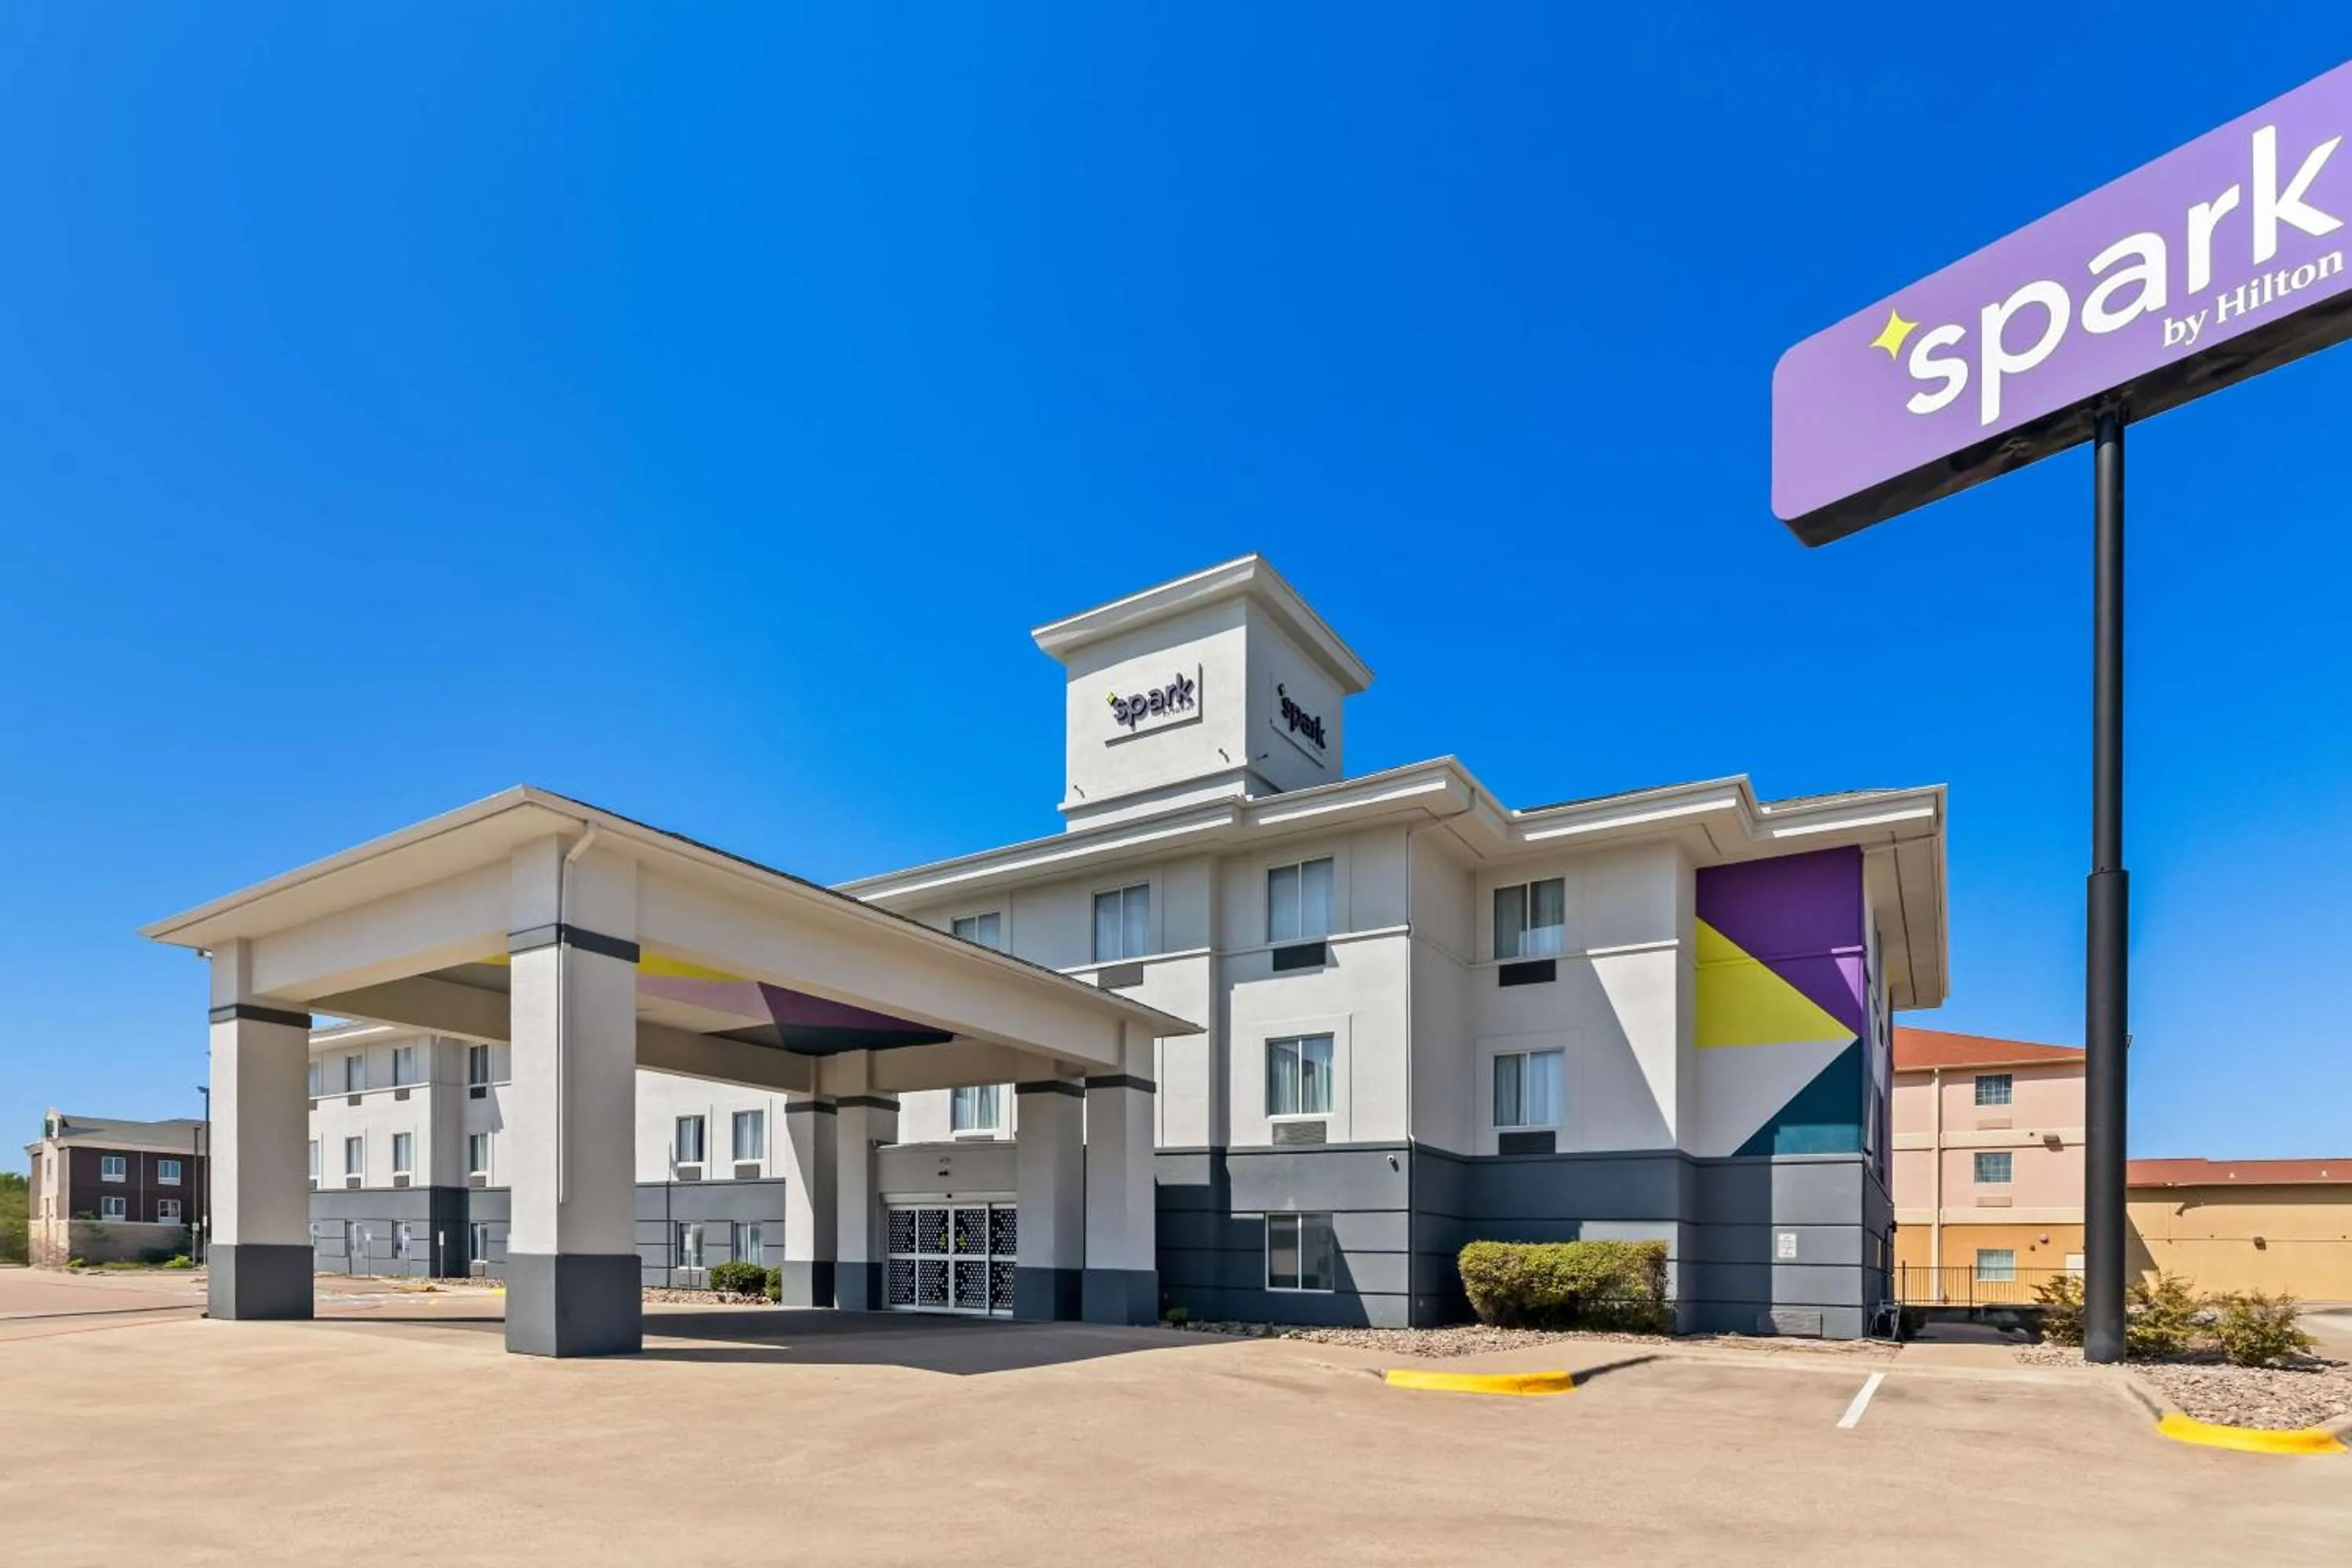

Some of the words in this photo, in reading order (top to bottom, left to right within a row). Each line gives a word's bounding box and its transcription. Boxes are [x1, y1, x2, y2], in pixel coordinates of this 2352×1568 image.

[1906, 124, 2344, 426] spark
[2162, 308, 2209, 347] by
[2216, 250, 2344, 324] Hilton
[1113, 673, 1195, 731] spark
[1281, 696, 1326, 749] spark
